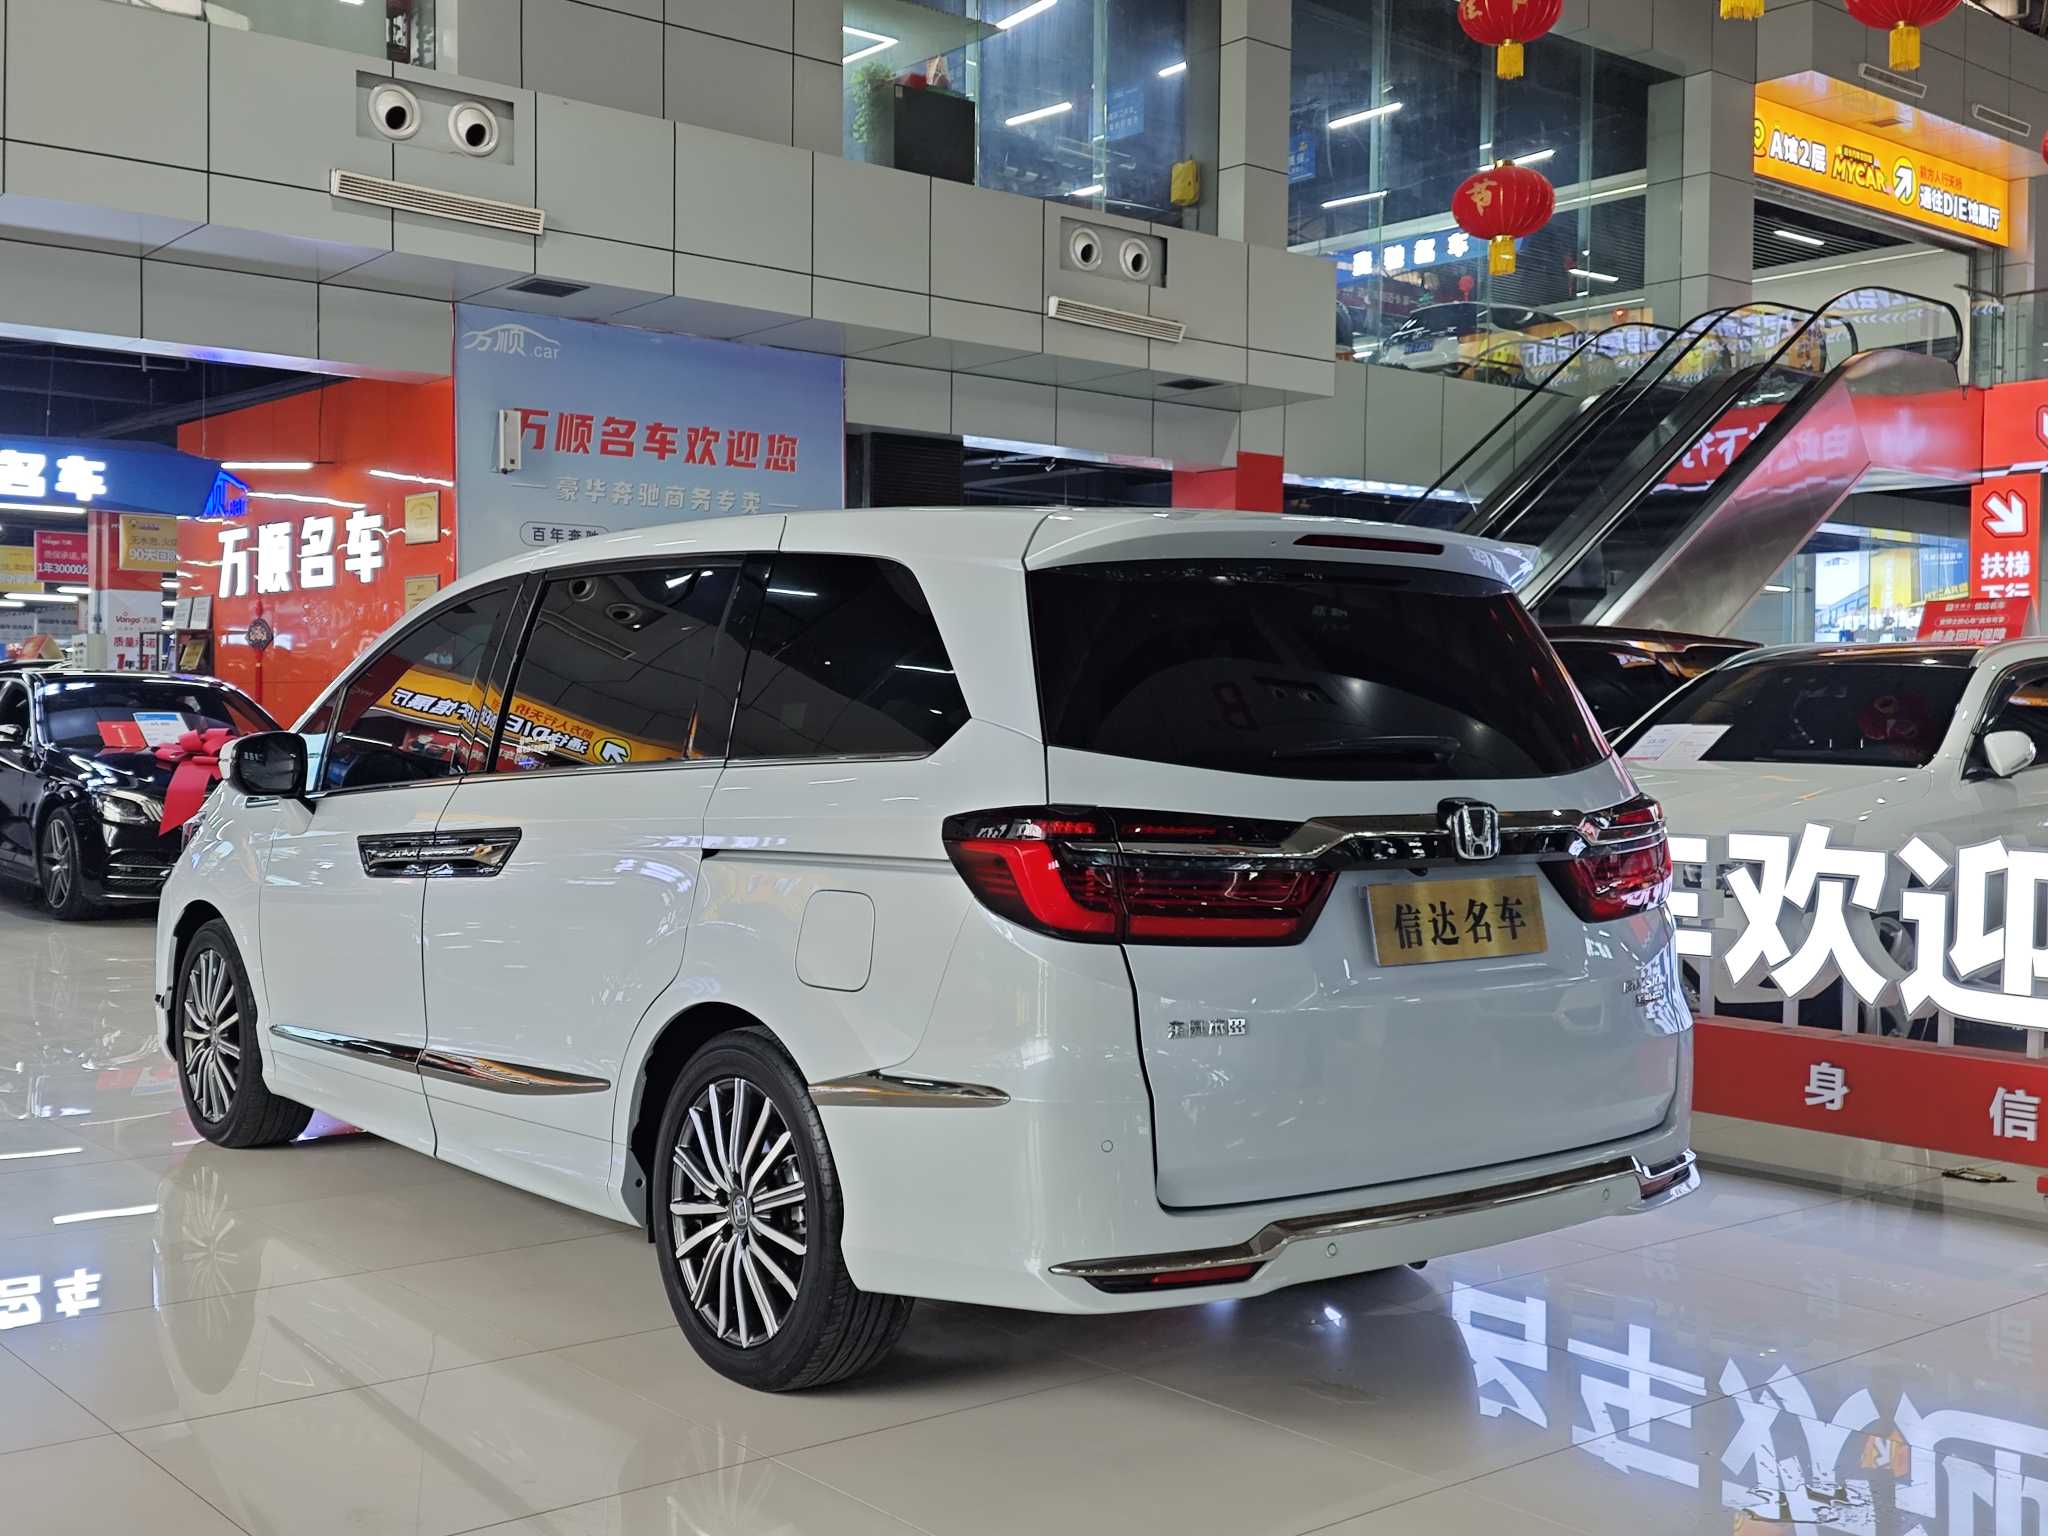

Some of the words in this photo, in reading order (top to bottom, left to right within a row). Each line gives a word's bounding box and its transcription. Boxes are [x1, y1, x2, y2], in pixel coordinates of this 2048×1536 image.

[513, 407, 800, 473] 万顺名车欢迎您
[557, 477, 762, 514] 豪华奔驰商务专卖
[218, 510, 384, 599] 万顺名车
[1981, 551, 2030, 579] 扶梯
[1394, 896, 1527, 950] 信达名车
[1804, 1063, 1850, 1110] 身
[1989, 1087, 2040, 1142] 信
